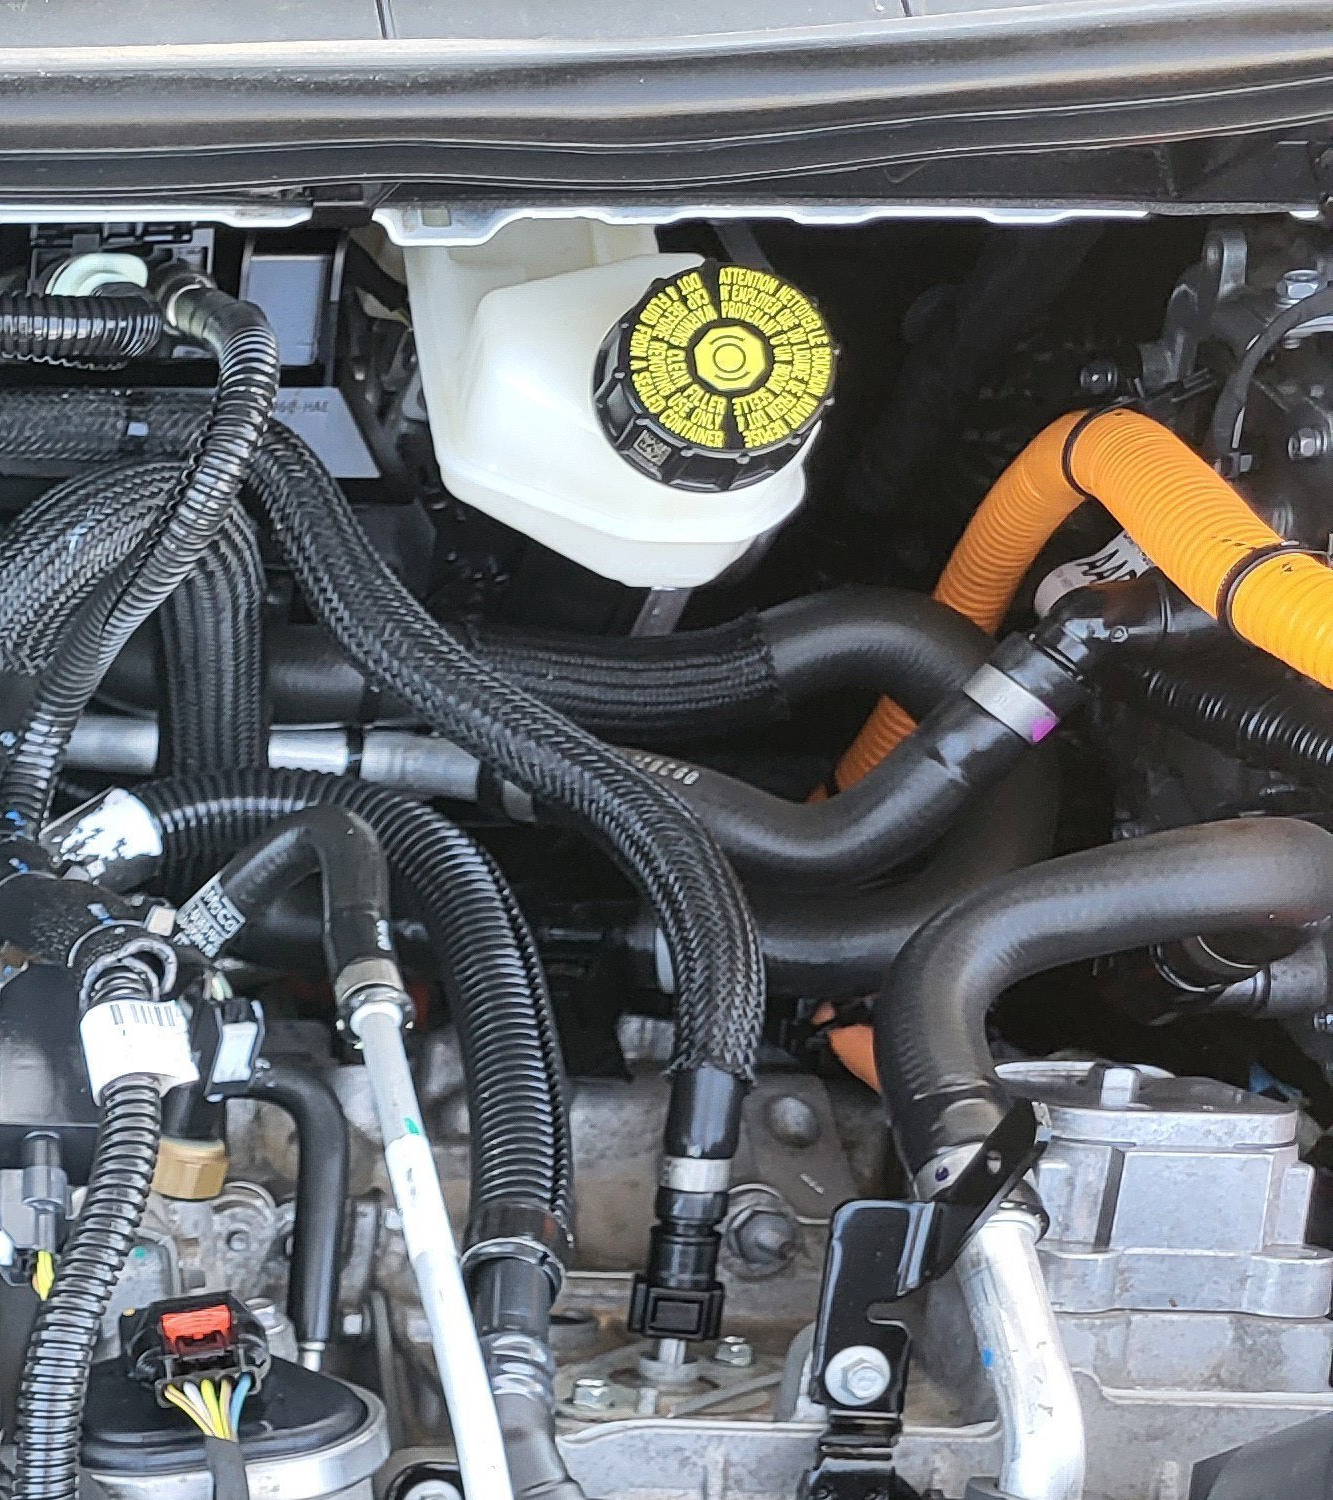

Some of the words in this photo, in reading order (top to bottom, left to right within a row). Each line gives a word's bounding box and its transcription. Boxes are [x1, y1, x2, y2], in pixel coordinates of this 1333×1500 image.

[719, 266, 779, 294] ATTENTION
[639, 293, 672, 325] FLUID
[687, 288, 711, 310] CAP
[776, 285, 821, 330] NETTOYER
[653, 300, 688, 341] BEFORE
[669, 305, 718, 347] WARNING
[721, 302, 783, 336] PROVENANT
[776, 308, 799, 330] QUE
[630, 324, 653, 357] FROM
[786, 329, 807, 344] DU
[808, 329, 830, 346] LE
[630, 359, 649, 370] A
[648, 341, 675, 397] REMOVING
[667, 348, 693, 389] CLEAN
[791, 344, 812, 381] LIQUIDE
[807, 346, 831, 397] BOUCHON
[632, 371, 667, 413] SEALED
[667, 392, 693, 415] USE
[683, 385, 727, 414] FILLER
[658, 408, 726, 448] CONTAINER
[690, 408, 722, 430] ONLY
[746, 409, 770, 429] DOT
[784, 394, 819, 429] AVANT
